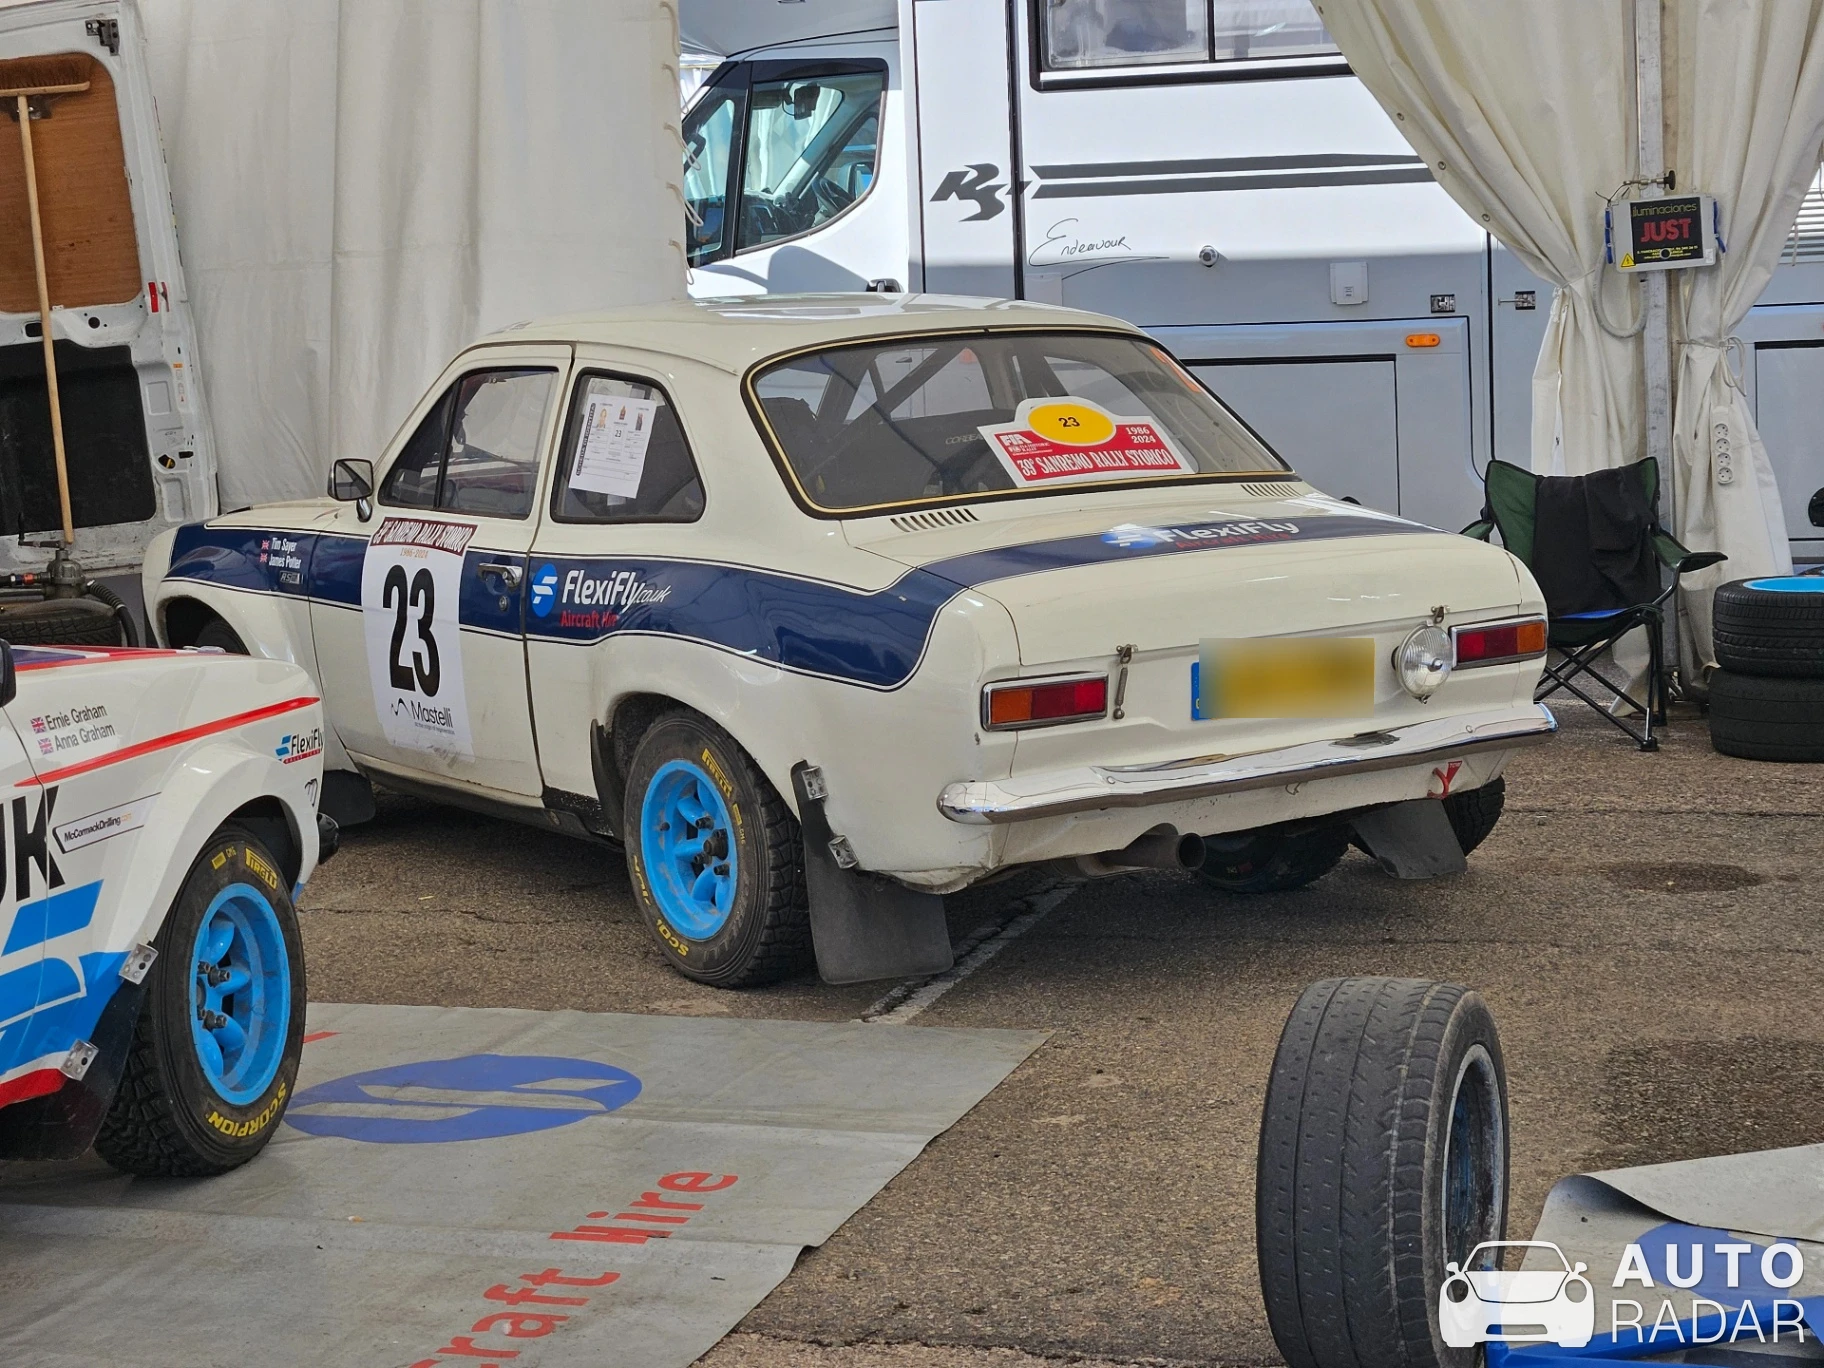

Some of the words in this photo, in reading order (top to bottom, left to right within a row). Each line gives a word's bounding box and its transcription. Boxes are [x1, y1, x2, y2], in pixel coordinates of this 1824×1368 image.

[1029, 218, 1132, 267] Endeavour
[1640, 218, 1692, 242] JUST
[614, 429, 622, 438] 23
[1058, 416, 1080, 428] 23
[1125, 426, 1150, 435] 1986
[1131, 435, 1156, 444] 2024
[1035, 452, 1093, 474] SANREMO
[1091, 449, 1129, 468] RALLY
[1123, 448, 1175, 466] STORICO
[1153, 521, 1300, 543] FlexiFly
[271, 538, 282, 550] Tim
[281, 539, 298, 553] Sayer
[268, 553, 286, 568] James
[285, 555, 302, 569] Potter
[383, 564, 440, 698] 23
[560, 610, 600, 629] Aircraft
[45, 712, 71, 731] Ernie
[70, 705, 108, 724] Graham
[410, 700, 454, 729] Mastelli
[54, 734, 80, 751] Anna
[80, 724, 116, 744] Graham
[291, 728, 324, 756] FlexiFly
[245, 847, 278, 890] PIRELLI
[207, 1082, 287, 1137] SCORPION
[549, 1171, 738, 1245] Hire
